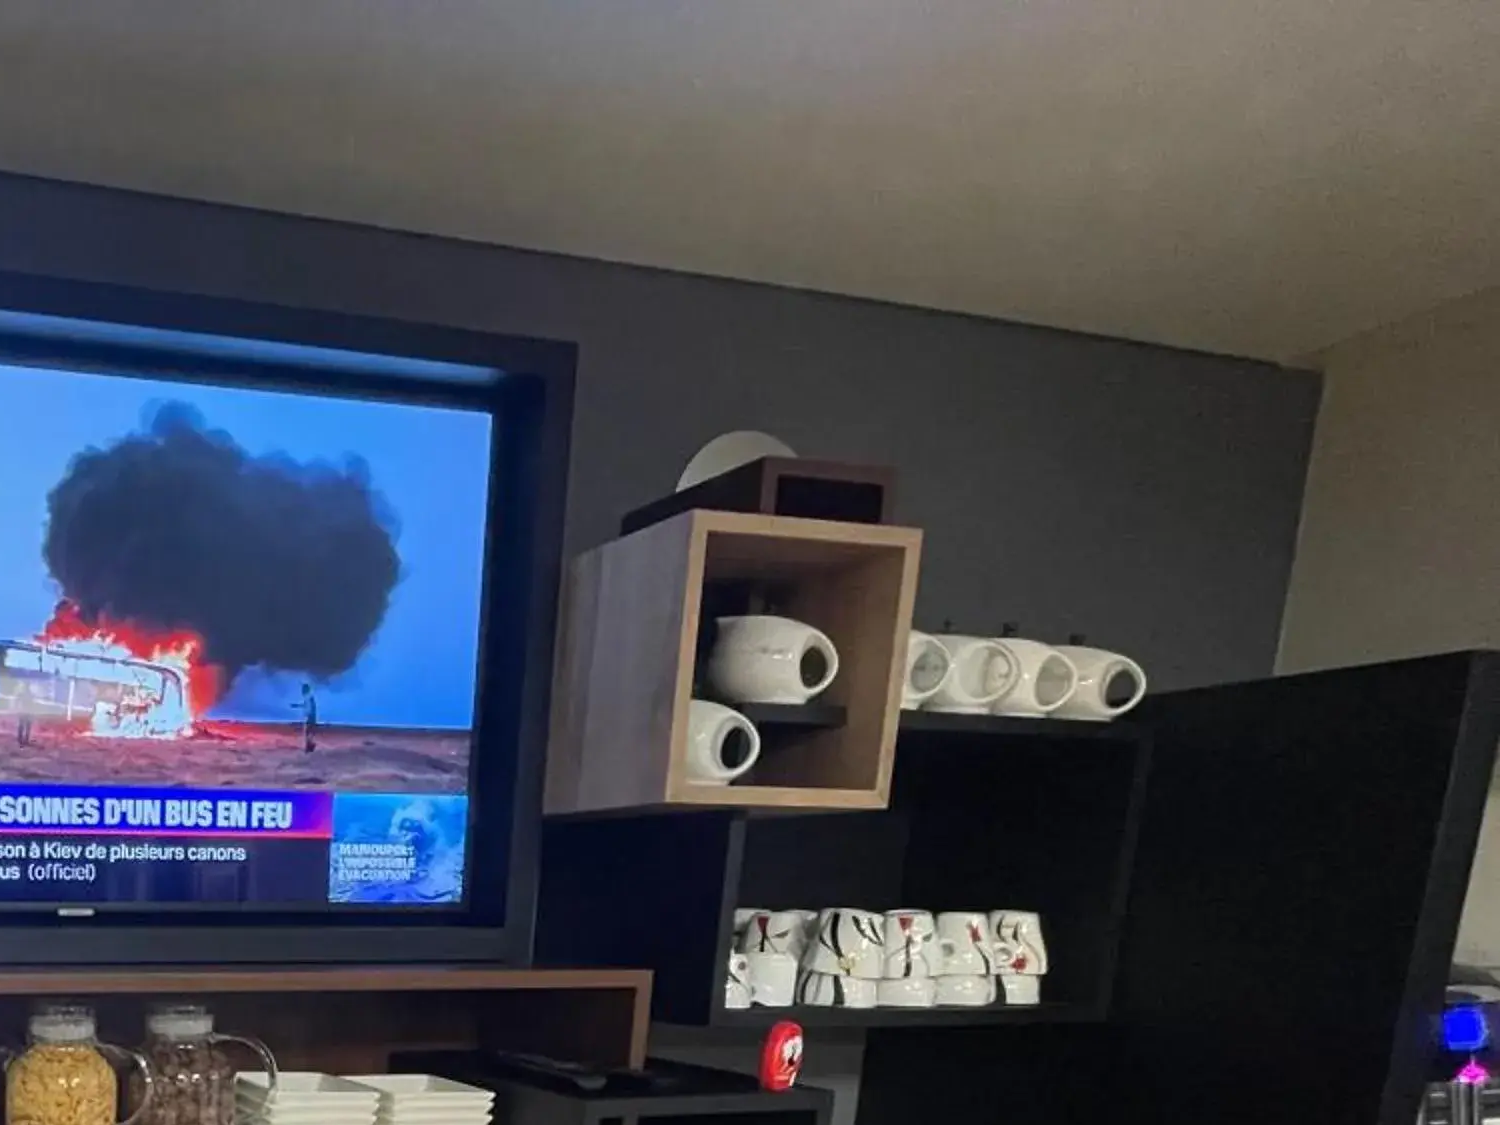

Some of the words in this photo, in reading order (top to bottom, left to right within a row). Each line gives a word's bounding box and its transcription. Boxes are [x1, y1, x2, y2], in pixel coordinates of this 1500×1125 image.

[104, 798, 162, 827] D'UN
[165, 800, 214, 828] BUS
[216, 801, 249, 828] EN
[251, 801, 294, 829] FEU
[29, 842, 42, 859] à
[43, 844, 83, 860] Kiev
[85, 844, 107, 861] de
[109, 844, 185, 864] plusieurs
[187, 847, 247, 862] canons
[27, 864, 97, 881] (officiel)
